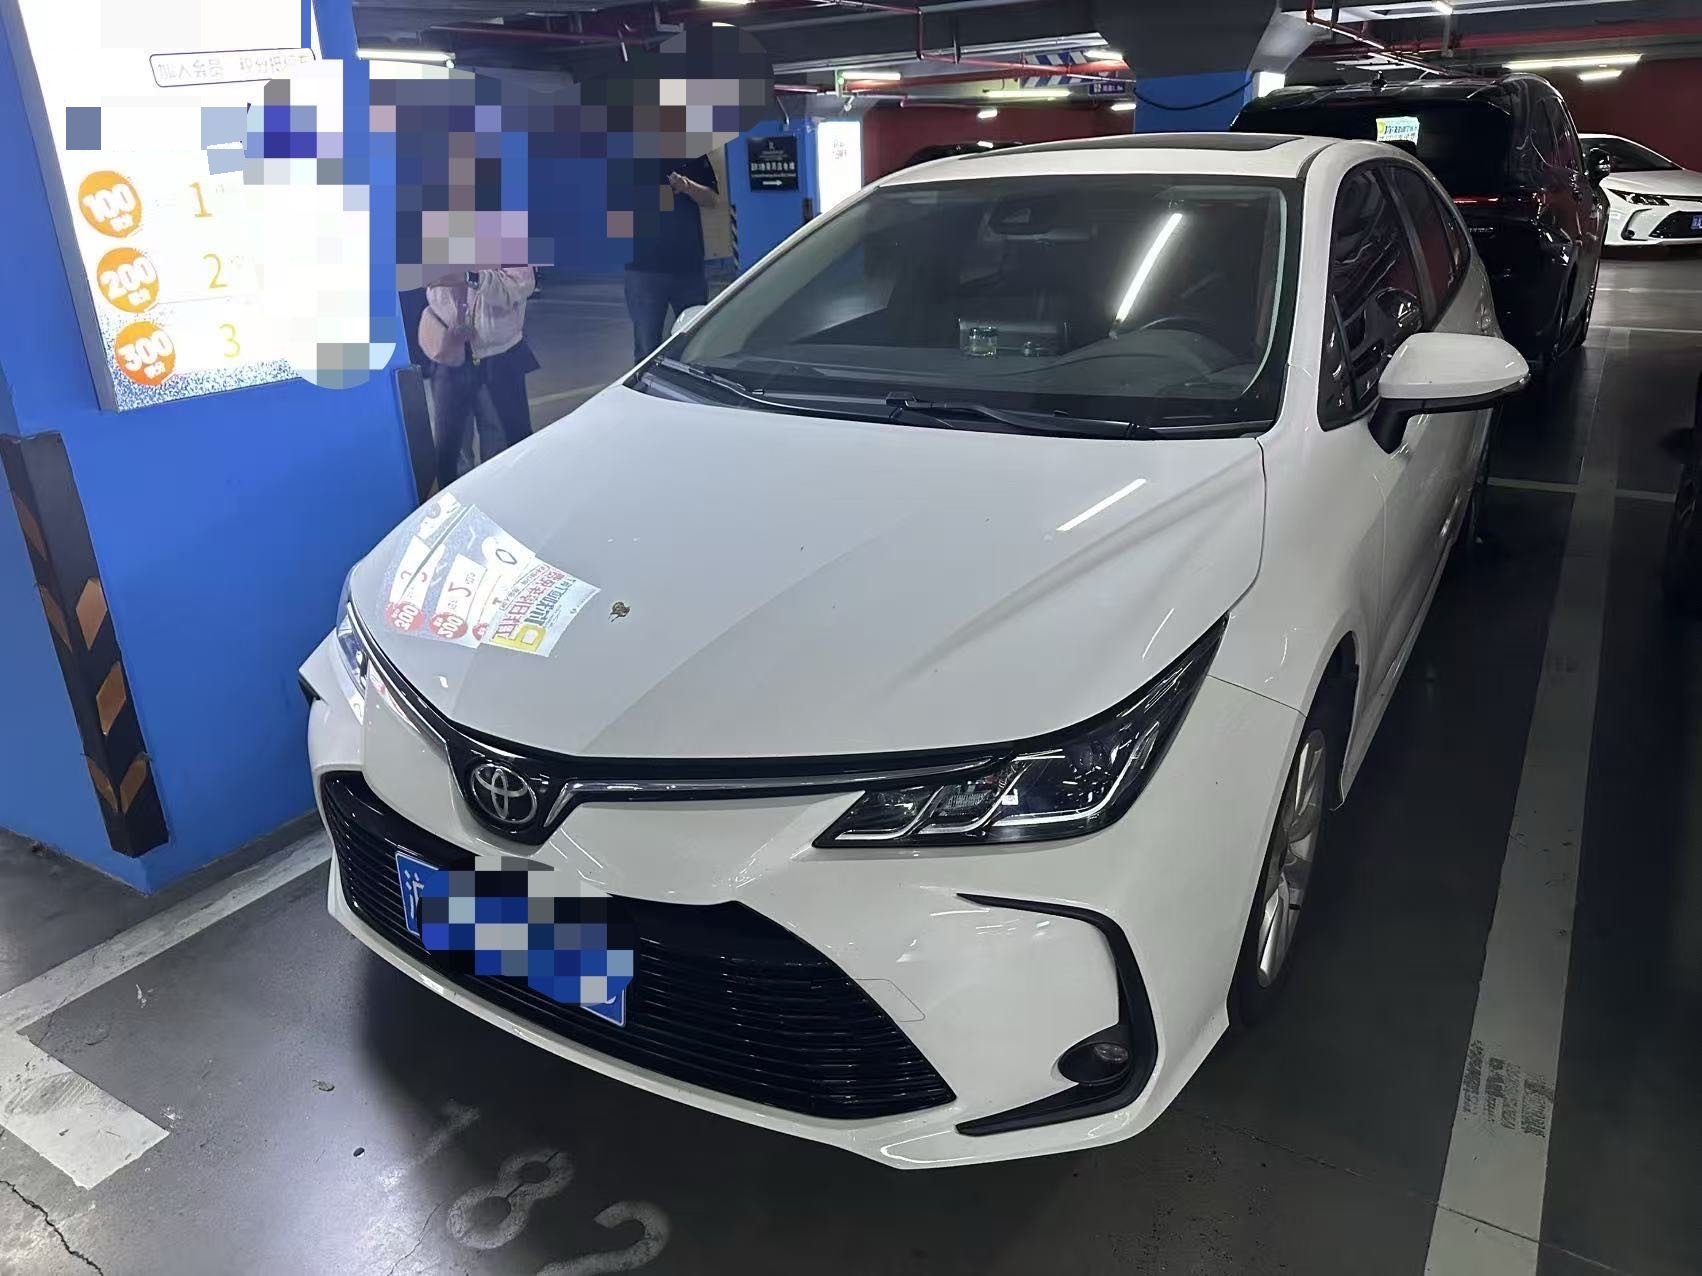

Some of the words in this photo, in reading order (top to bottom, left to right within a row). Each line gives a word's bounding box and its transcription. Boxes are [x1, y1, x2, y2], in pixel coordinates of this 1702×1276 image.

[158, 59, 223, 79] 加入会员
[82, 183, 137, 222] 100
[189, 181, 213, 218] 1
[100, 256, 158, 299] 200
[203, 253, 228, 289] 2
[118, 330, 174, 371] 300
[219, 323, 241, 358] 3
